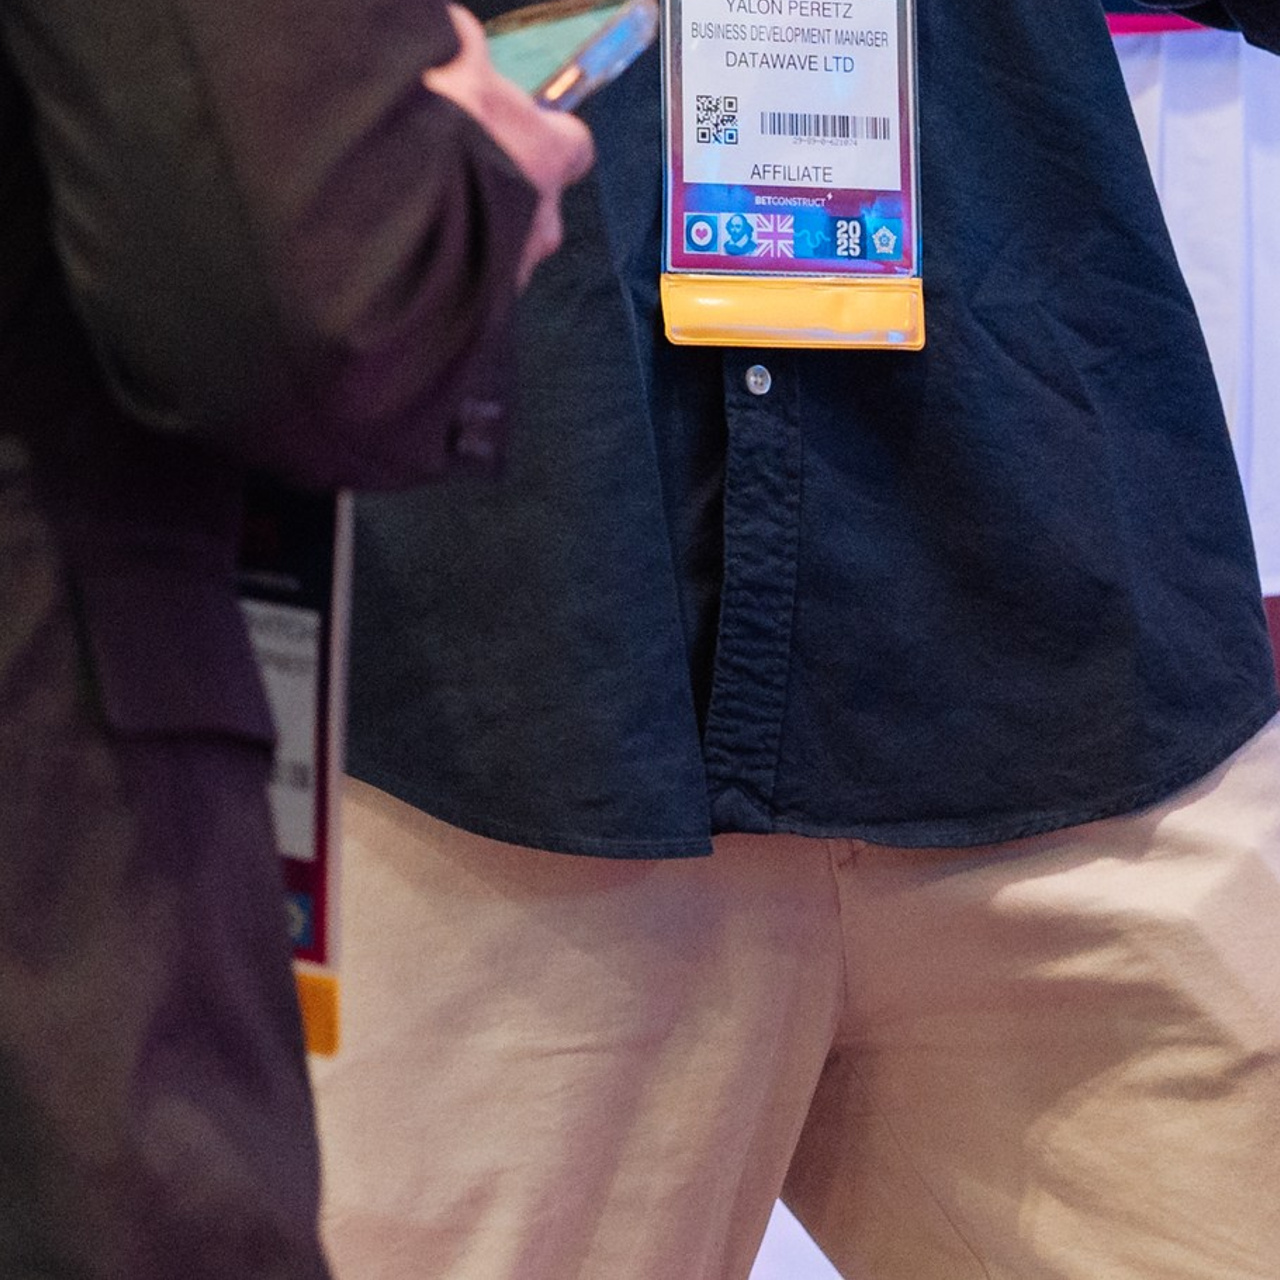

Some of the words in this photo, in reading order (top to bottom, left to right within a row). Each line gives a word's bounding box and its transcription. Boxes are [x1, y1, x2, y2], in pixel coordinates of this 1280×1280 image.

[788, 0, 853, 20] PERETZ
[691, 22, 748, 41] BUSINESS
[750, 25, 832, 45] DEVELOPMENT
[835, 29, 889, 48] MANAGER
[725, 51, 818, 71] DATAWAVE
[823, 56, 855, 74] LTD
[750, 163, 833, 184] AFFILIATE
[754, 194, 826, 208] BETCONSTRUCT
[836, 219, 862, 239] 20
[836, 237, 862, 257] 25
